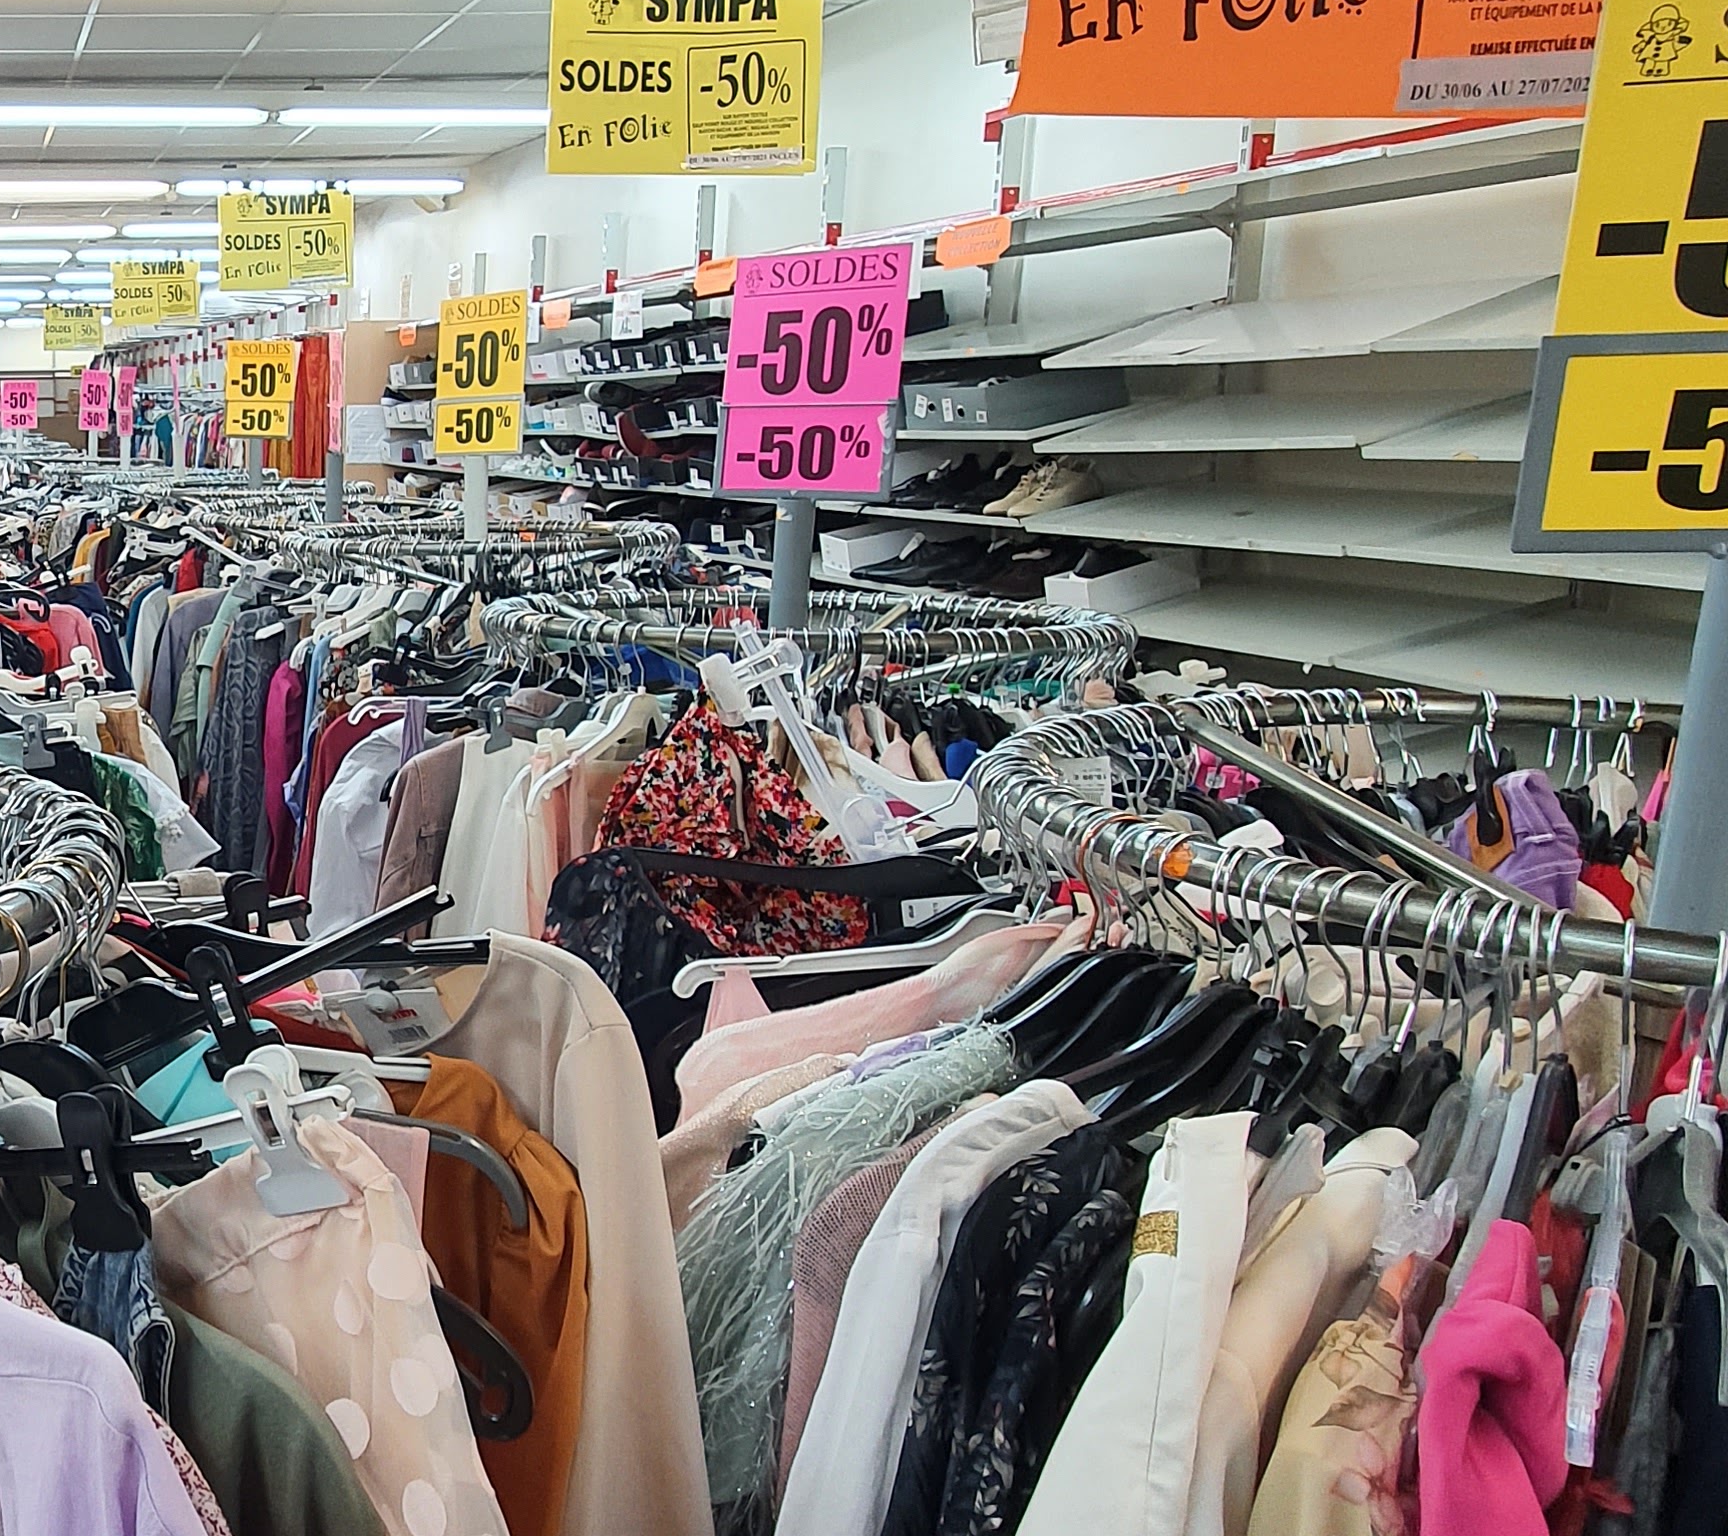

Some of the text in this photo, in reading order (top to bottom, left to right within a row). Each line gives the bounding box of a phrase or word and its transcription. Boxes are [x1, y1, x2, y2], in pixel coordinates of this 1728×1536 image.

[1470, 8, 1484, 21] ET
[1485, 3, 1559, 23] ÉQUIPEMENT
[1561, 3, 1577, 16] DE
[1578, 2, 1594, 15] LA
[1470, 36, 1596, 55] REMISE EFFECTUÉE EN
[560, 59, 672, 92] SOLDES
[700, 51, 791, 108] -50%
[1410, 77, 1590, 101] DU 30/06 AU 27/07/202
[557, 123, 592, 149] En
[265, 193, 331, 215] SYMPA
[224, 234, 281, 251] SOLDES
[294, 229, 340, 257] -50%
[142, 260, 185, 275] SYMPA
[770, 252, 900, 289] SOLDES
[114, 287, 153, 299] SOLDES
[456, 294, 521, 320] SOLDES
[241, 343, 291, 355] SOLDES
[442, 328, 520, 390] -50%
[736, 302, 894, 396] -50%
[231, 362, 291, 397] -50%
[232, 409, 285, 431] -50%
[443, 405, 512, 445] -50%
[736, 423, 871, 481] -50%
